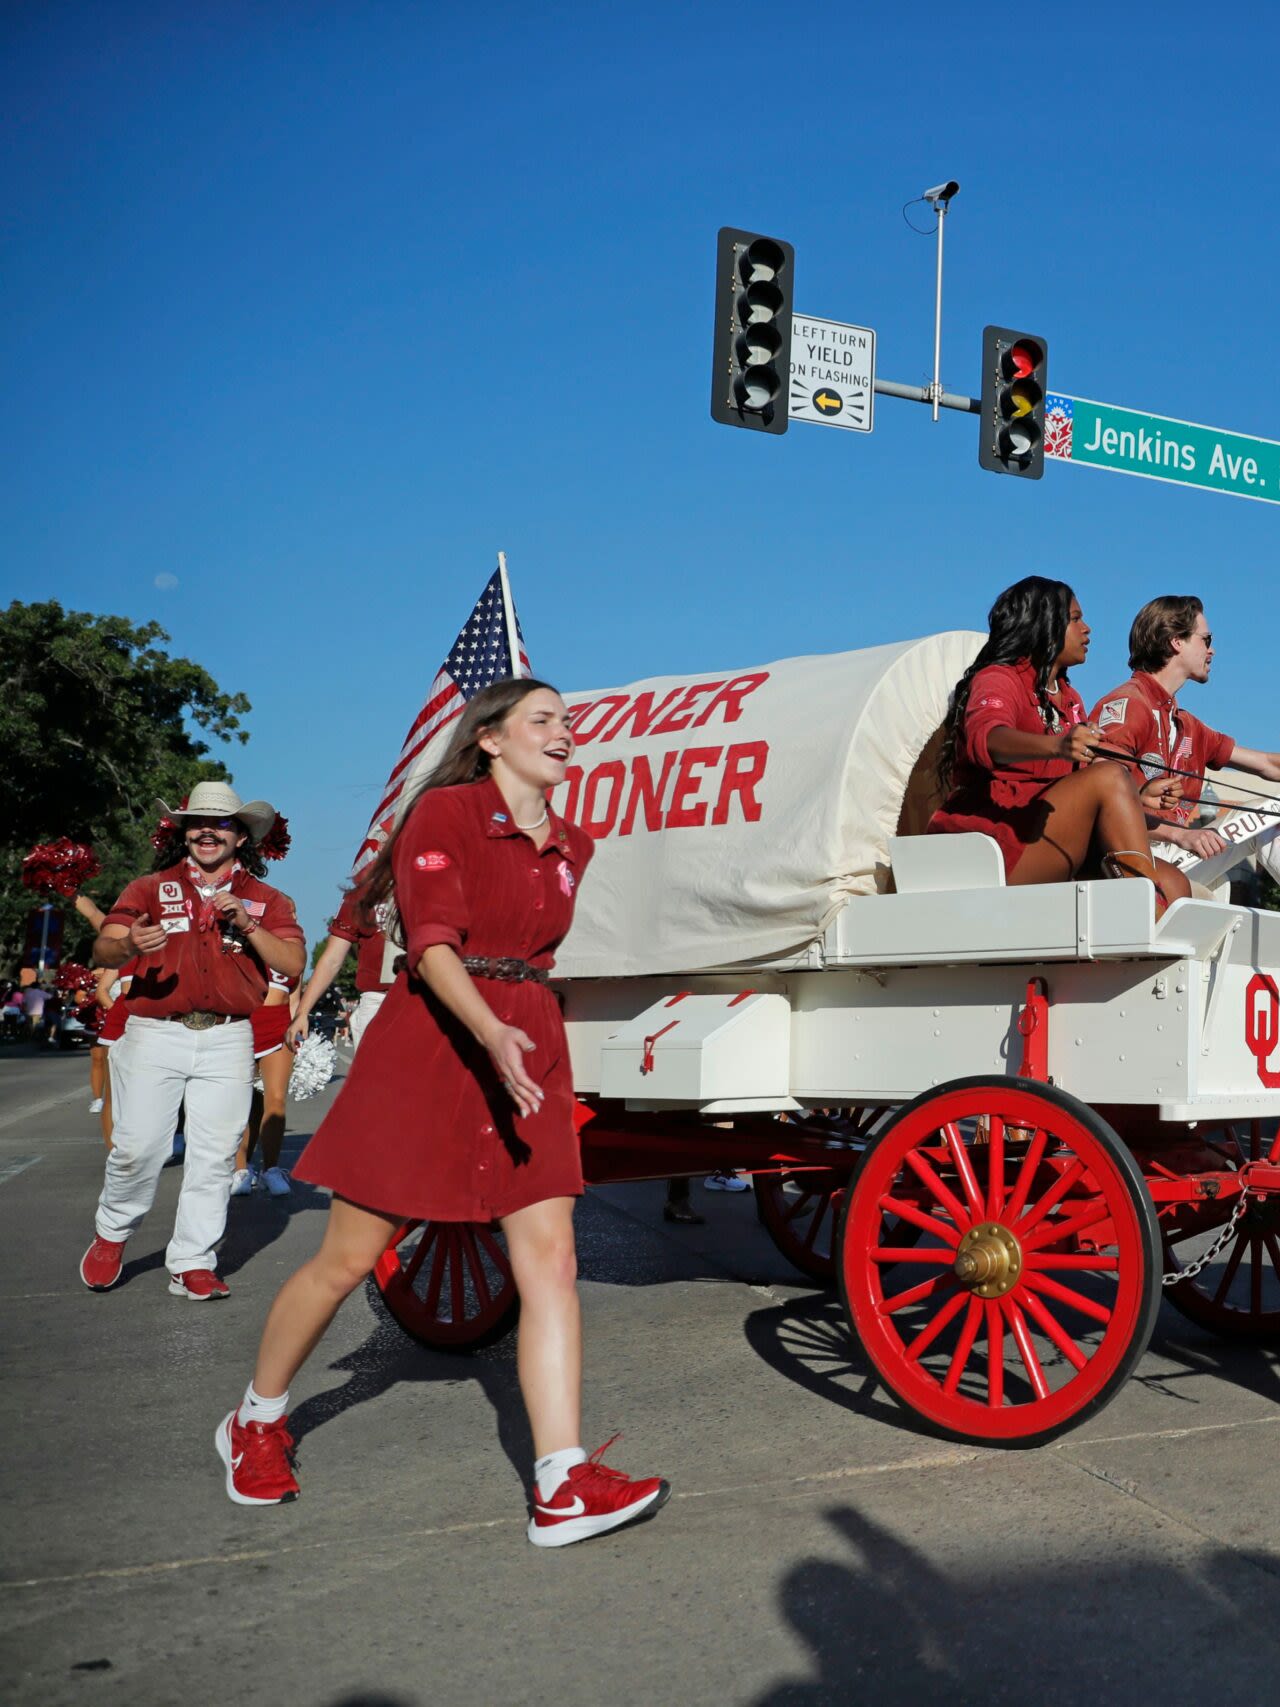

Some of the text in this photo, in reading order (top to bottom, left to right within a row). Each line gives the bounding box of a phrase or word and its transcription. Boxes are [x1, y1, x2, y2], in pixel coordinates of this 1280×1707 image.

[793, 324, 866, 349] LEFT TURN
[807, 343, 853, 366] YIELD
[789, 362, 869, 388] ON FLASHING
[1083, 417, 1266, 486] Jenkins Ave.
[567, 672, 770, 746] ONER
[163, 884, 178, 898] OU
